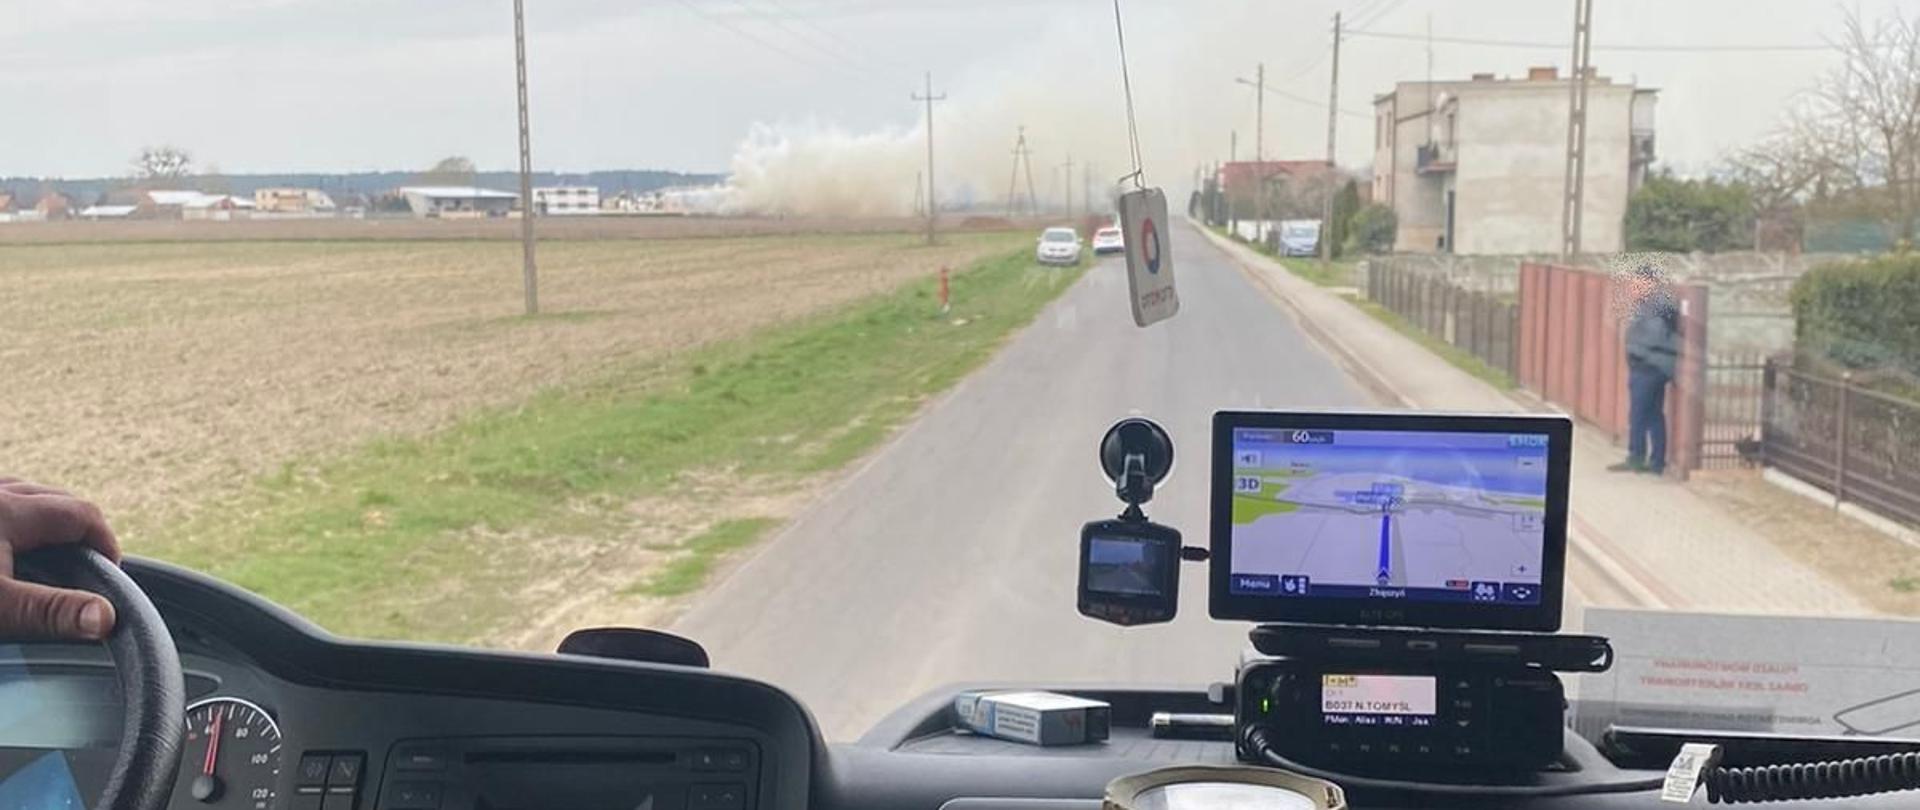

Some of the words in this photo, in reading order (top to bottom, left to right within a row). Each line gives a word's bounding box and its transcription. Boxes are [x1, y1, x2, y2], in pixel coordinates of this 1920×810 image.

[1292, 430, 1309, 443] 60
[1238, 478, 1259, 490] 3D
[1240, 578, 1271, 589] Menu
[235, 728, 249, 739] 80
[251, 753, 268, 764] 100
[252, 788, 268, 799] 120
